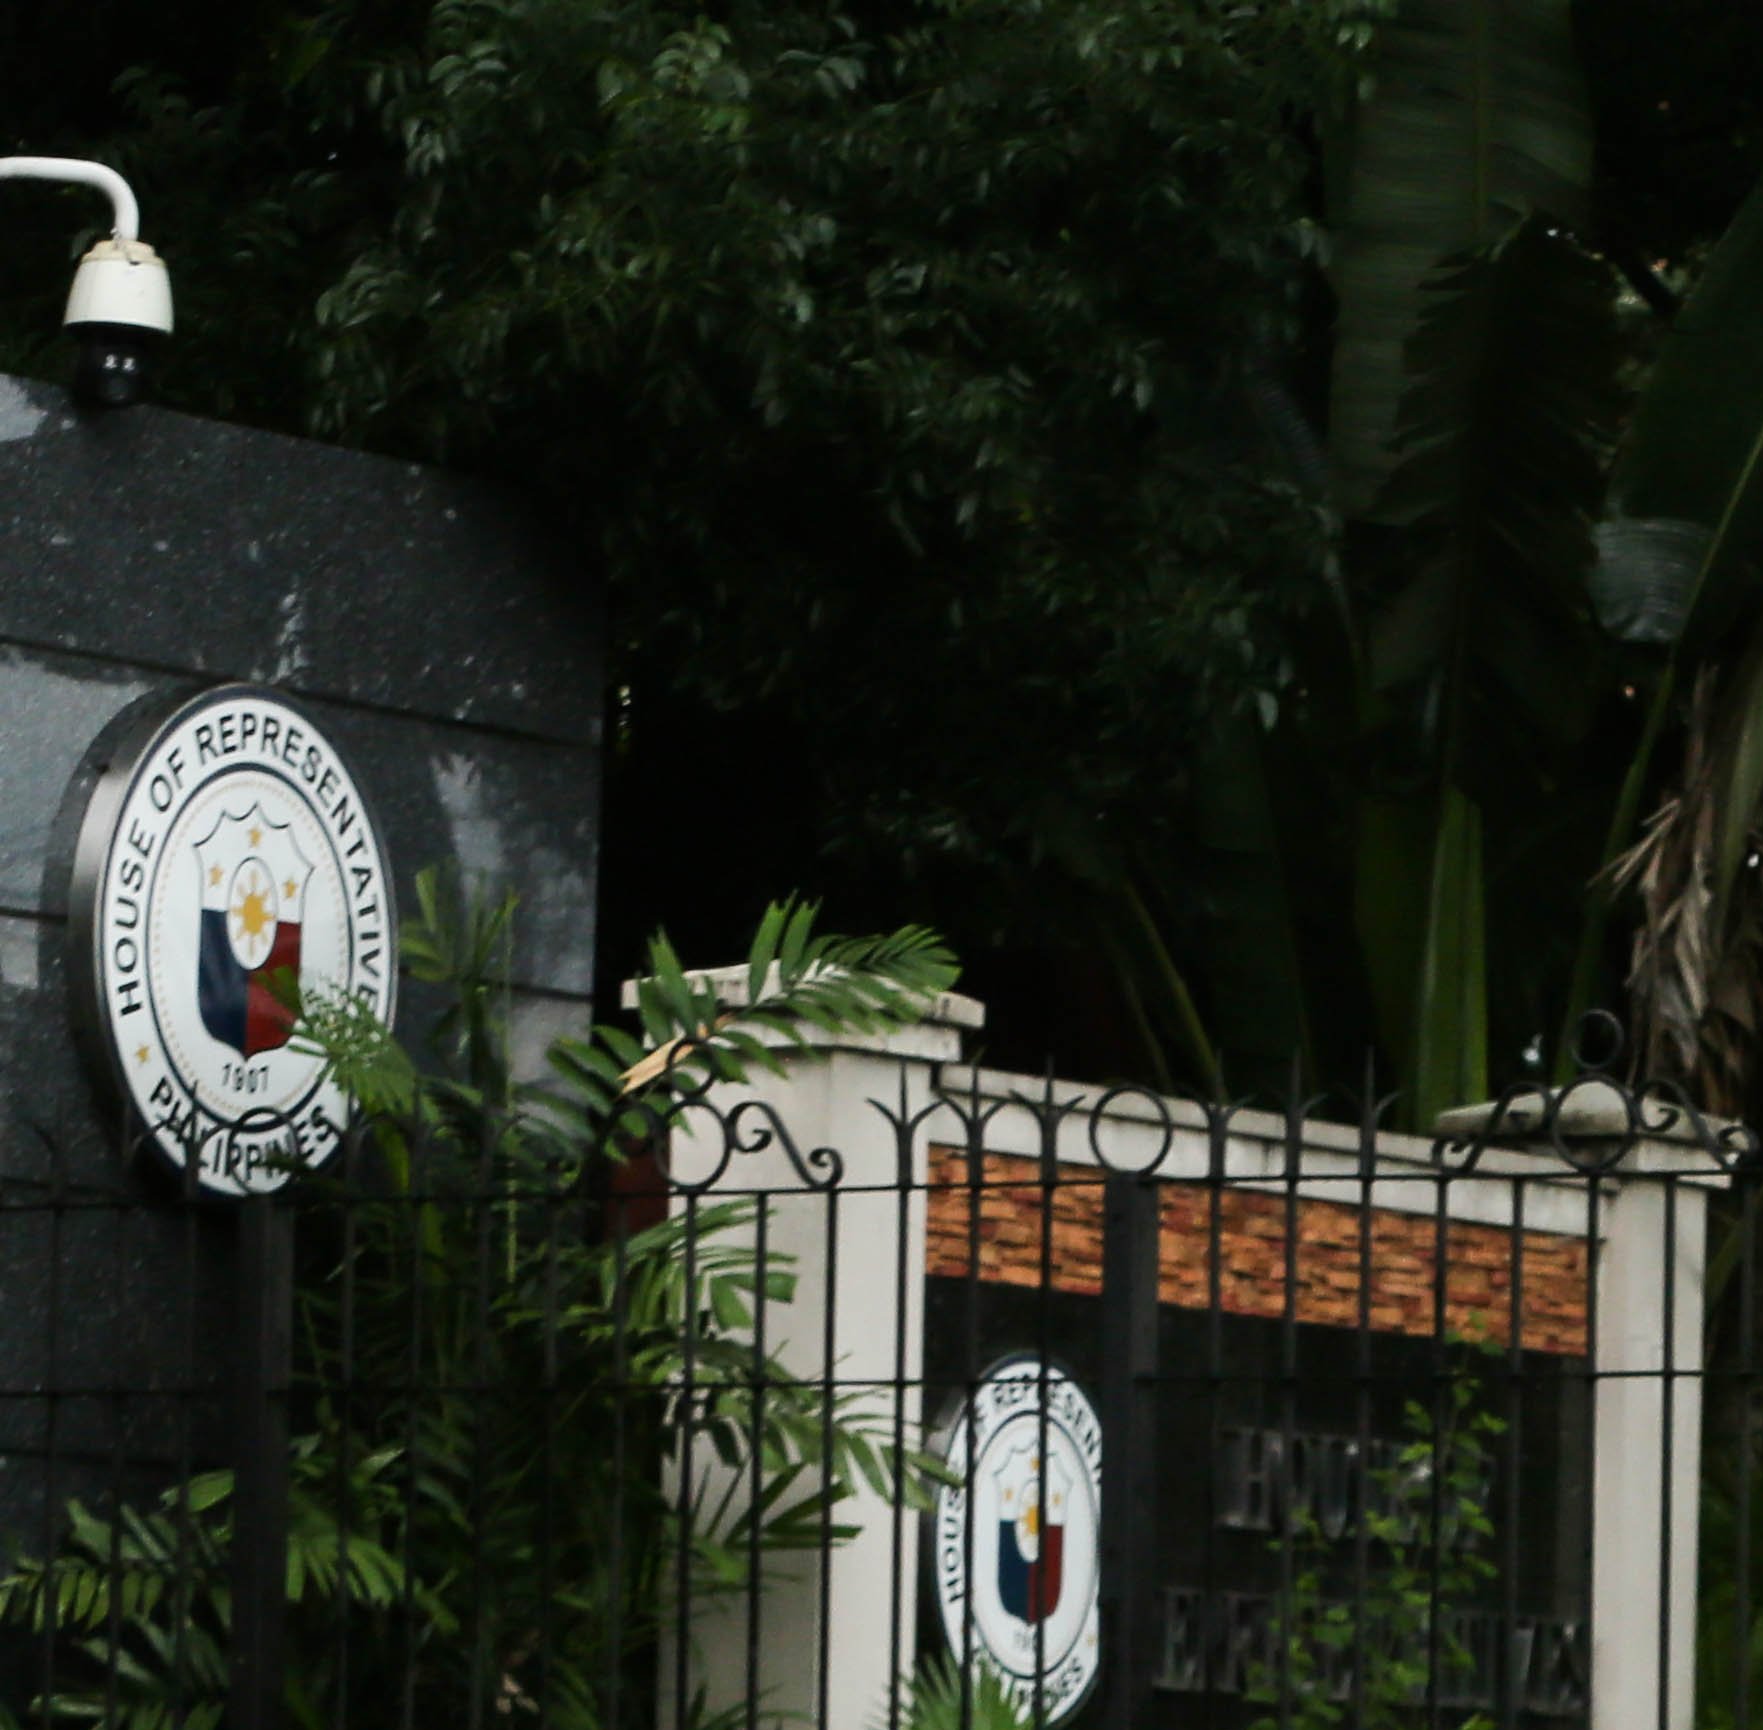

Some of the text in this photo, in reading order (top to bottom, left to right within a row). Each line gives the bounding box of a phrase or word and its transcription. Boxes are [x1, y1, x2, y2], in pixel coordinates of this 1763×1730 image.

[114, 713, 381, 1016] HOUSE OF REPRESENTATIVE
